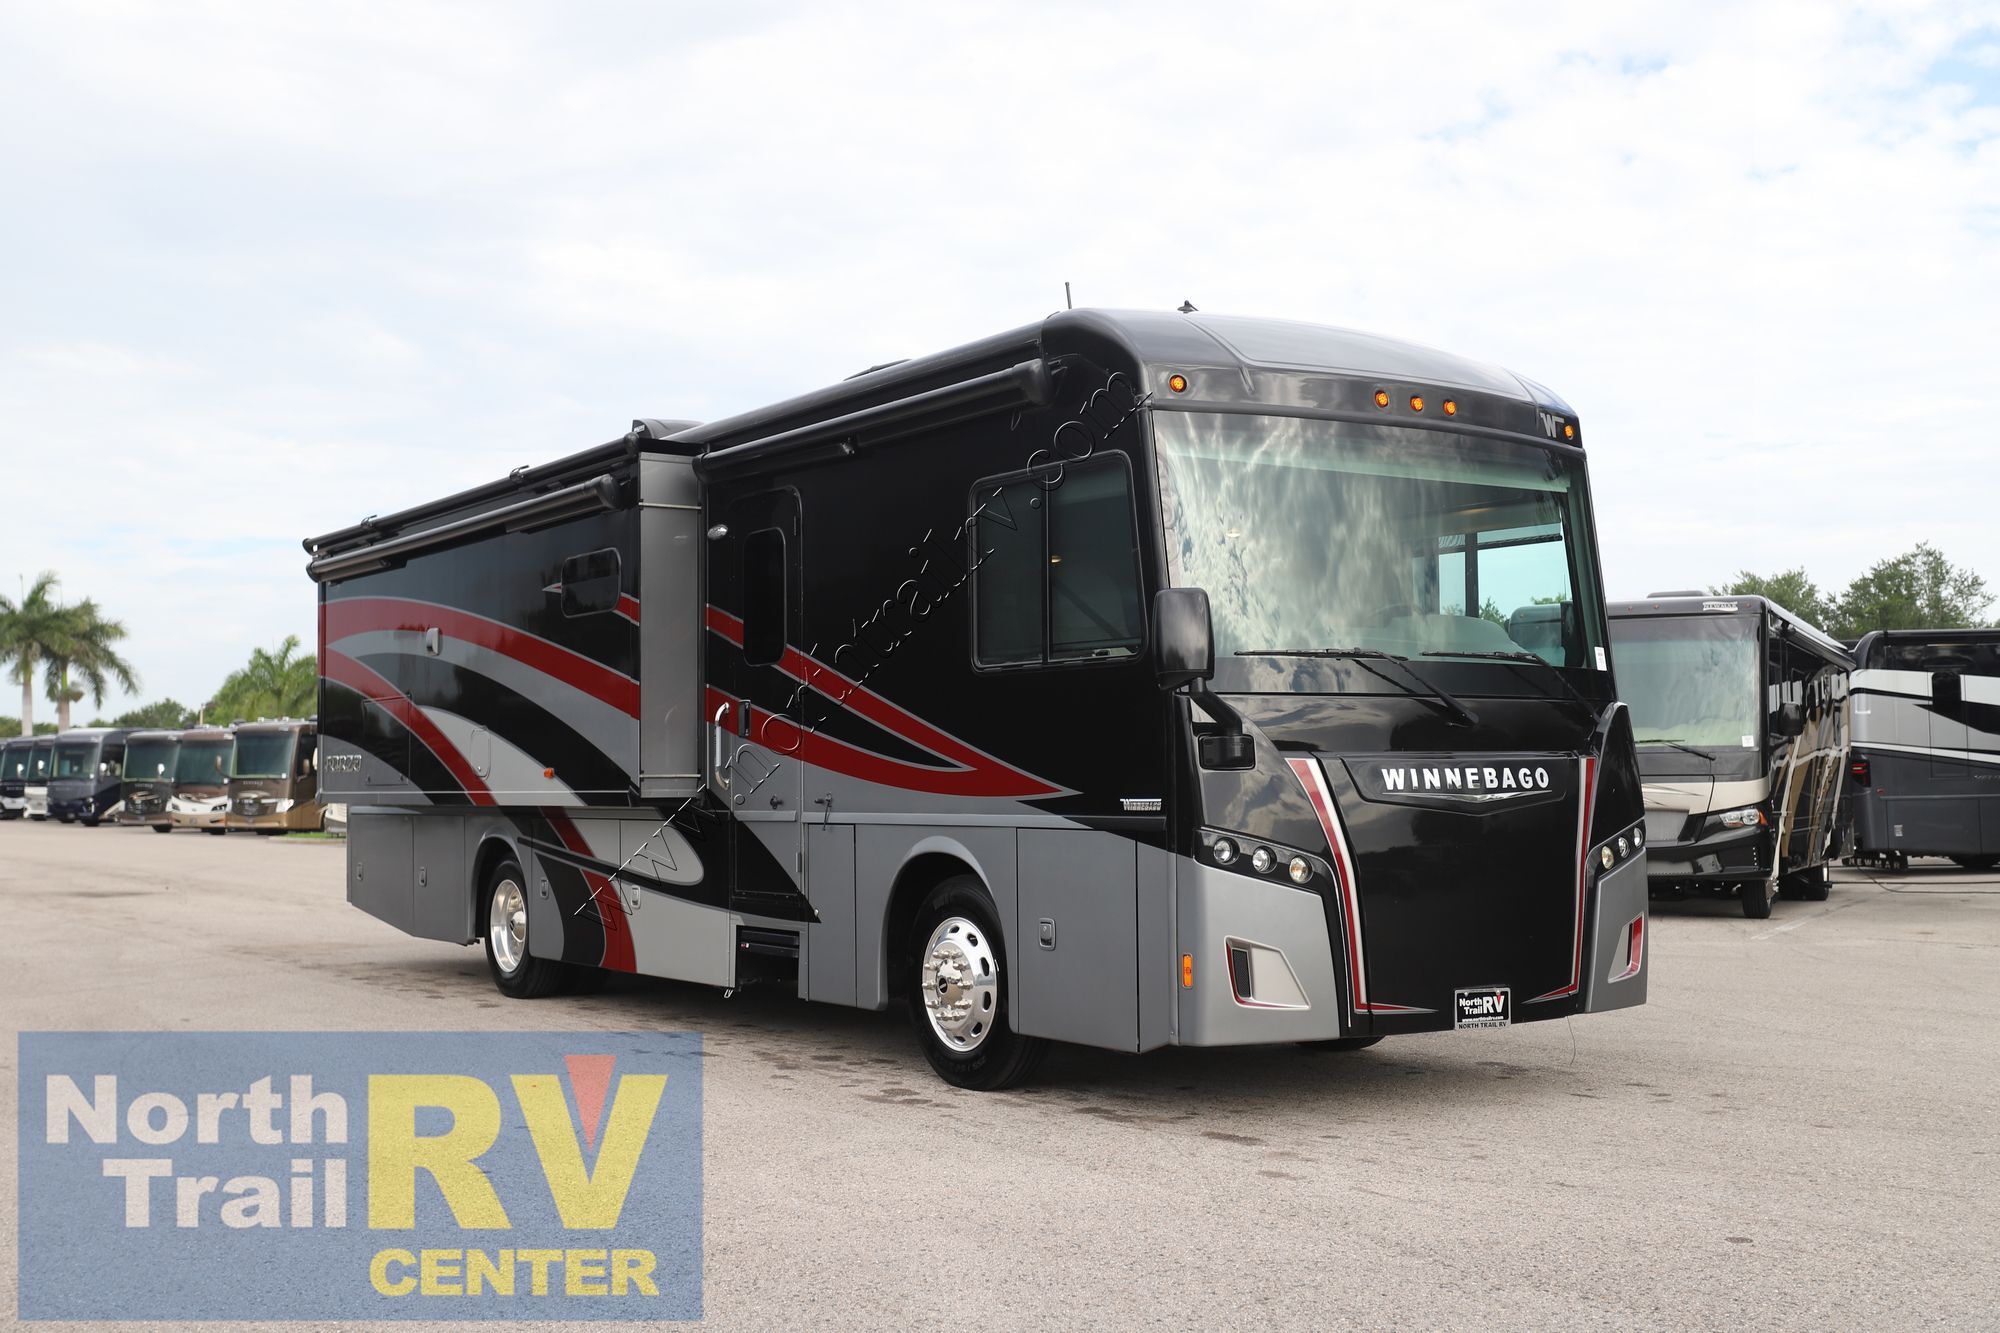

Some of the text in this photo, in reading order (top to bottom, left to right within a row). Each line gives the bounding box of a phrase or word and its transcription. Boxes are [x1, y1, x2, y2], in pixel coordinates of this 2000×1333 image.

[1381, 767, 1550, 790] WINNEBAGO
[1848, 858, 1901, 869] NEWMAR
[1460, 995, 1504, 1013] North RV
[1464, 1006, 1482, 1015] Trail
